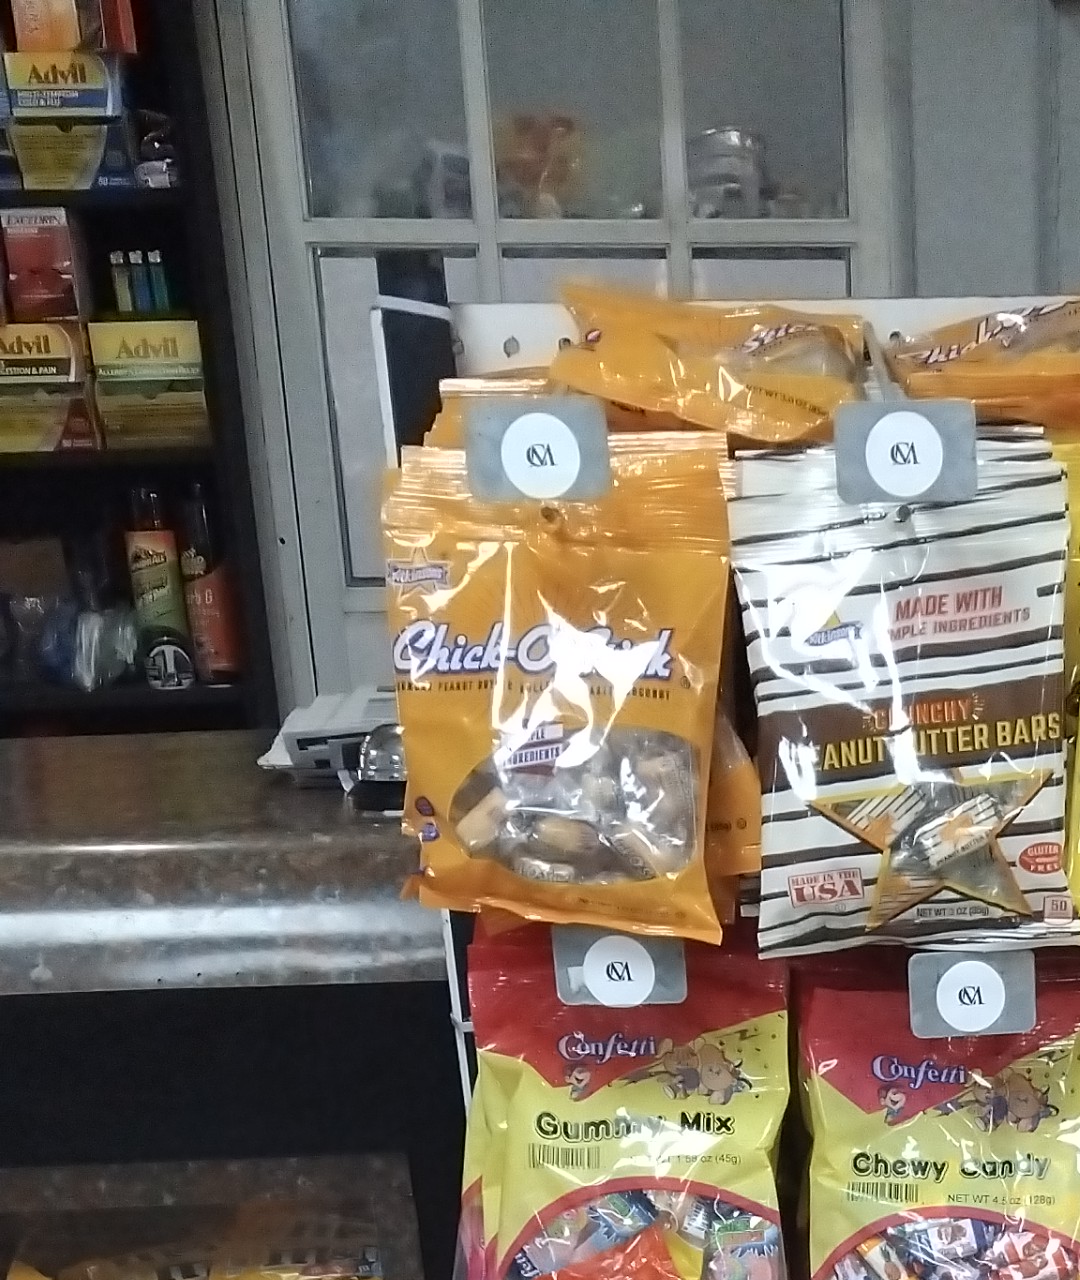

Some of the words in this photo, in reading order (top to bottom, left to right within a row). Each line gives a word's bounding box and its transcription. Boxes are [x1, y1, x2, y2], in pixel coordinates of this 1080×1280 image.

[28, 62, 86, 84] Advil
[116, 337, 180, 359] Advil
[894, 594, 949, 622] MADE
[953, 586, 1003, 616] WITH
[932, 607, 1031, 636] INGREDIENTS
[813, 736, 888, 773] EANUT
[912, 723, 990, 758] UTTER
[995, 713, 1061, 747] BARS
[793, 879, 863, 904] USA
[557, 1030, 656, 1065] Confetti
[870, 1053, 967, 1089] Confetti
[680, 1111, 736, 1135] Mix
[714, 1153, 743, 1166] (45g)
[851, 1151, 949, 1184] Chewy
[959, 1151, 1052, 1183] Candy
[946, 1192, 970, 1205] NET
[971, 1193, 990, 1205] WT
